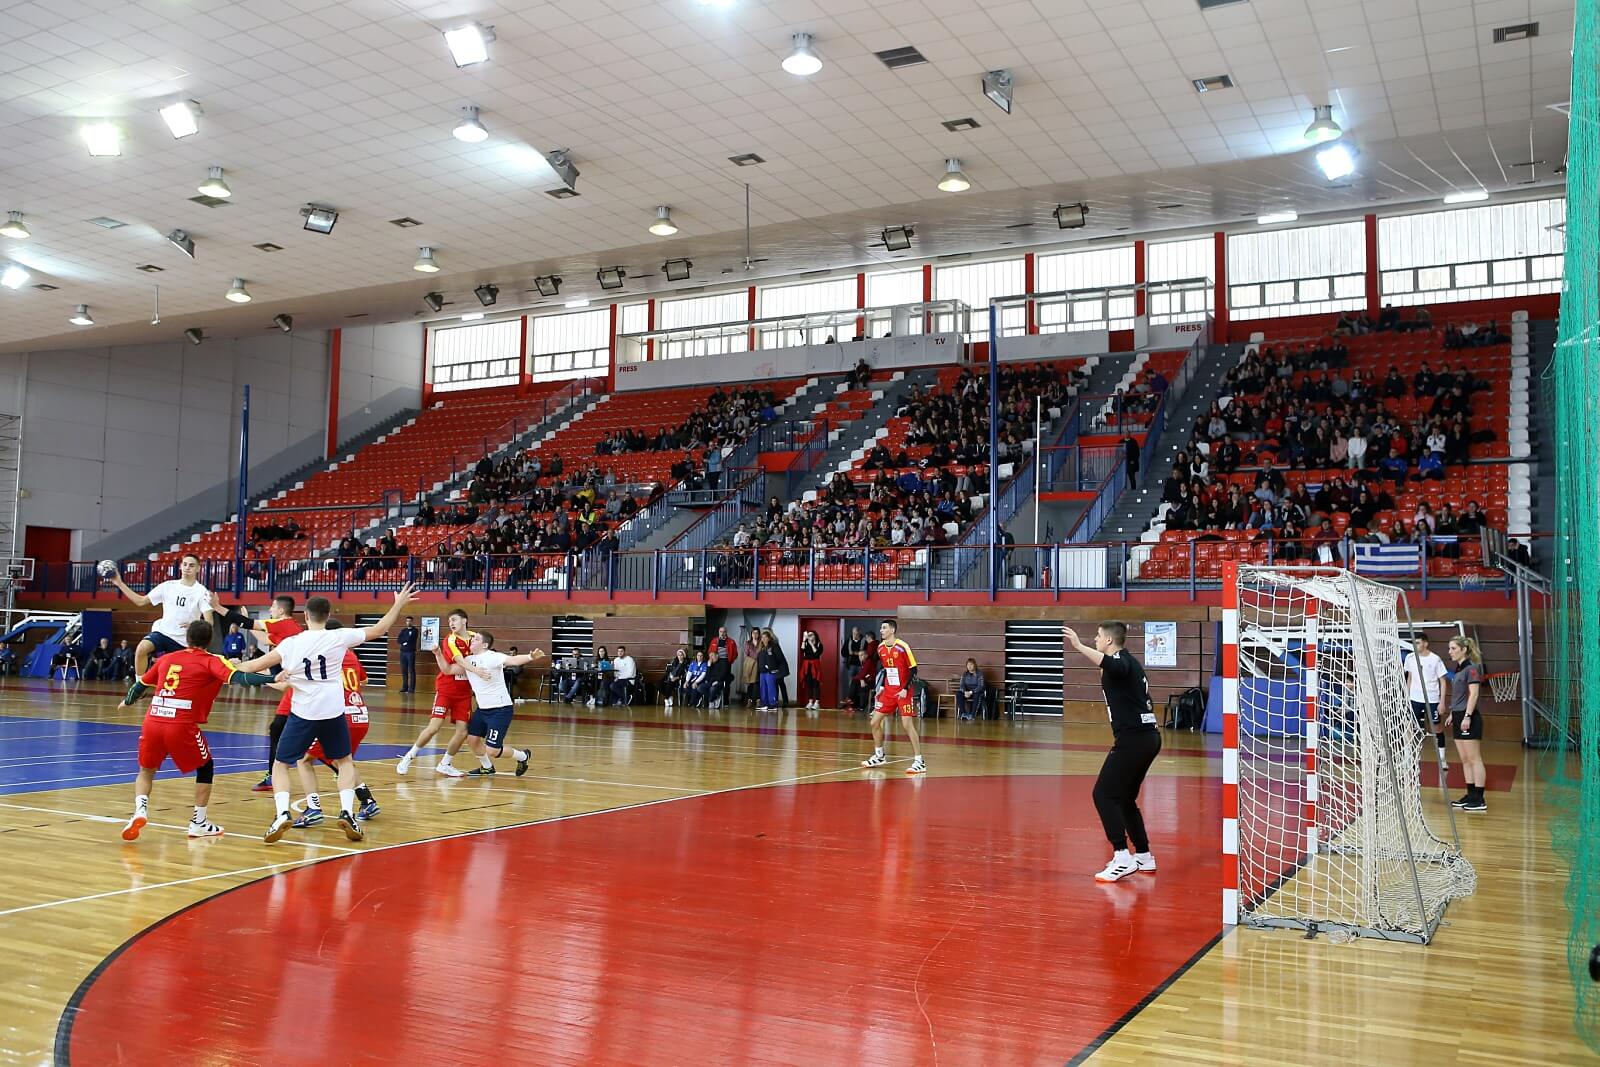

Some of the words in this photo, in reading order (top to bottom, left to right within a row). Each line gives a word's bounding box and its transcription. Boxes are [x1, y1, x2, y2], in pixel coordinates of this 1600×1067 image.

[1175, 324, 1202, 333] PRESS
[934, 337, 946, 345] T.V
[619, 365, 638, 373] PRESS
[176, 595, 186, 607] 10
[886, 657, 894, 667] 13
[302, 654, 328, 681] 11
[163, 664, 183, 690] 5
[903, 704, 912, 714] 13
[488, 728, 499, 741] 13
